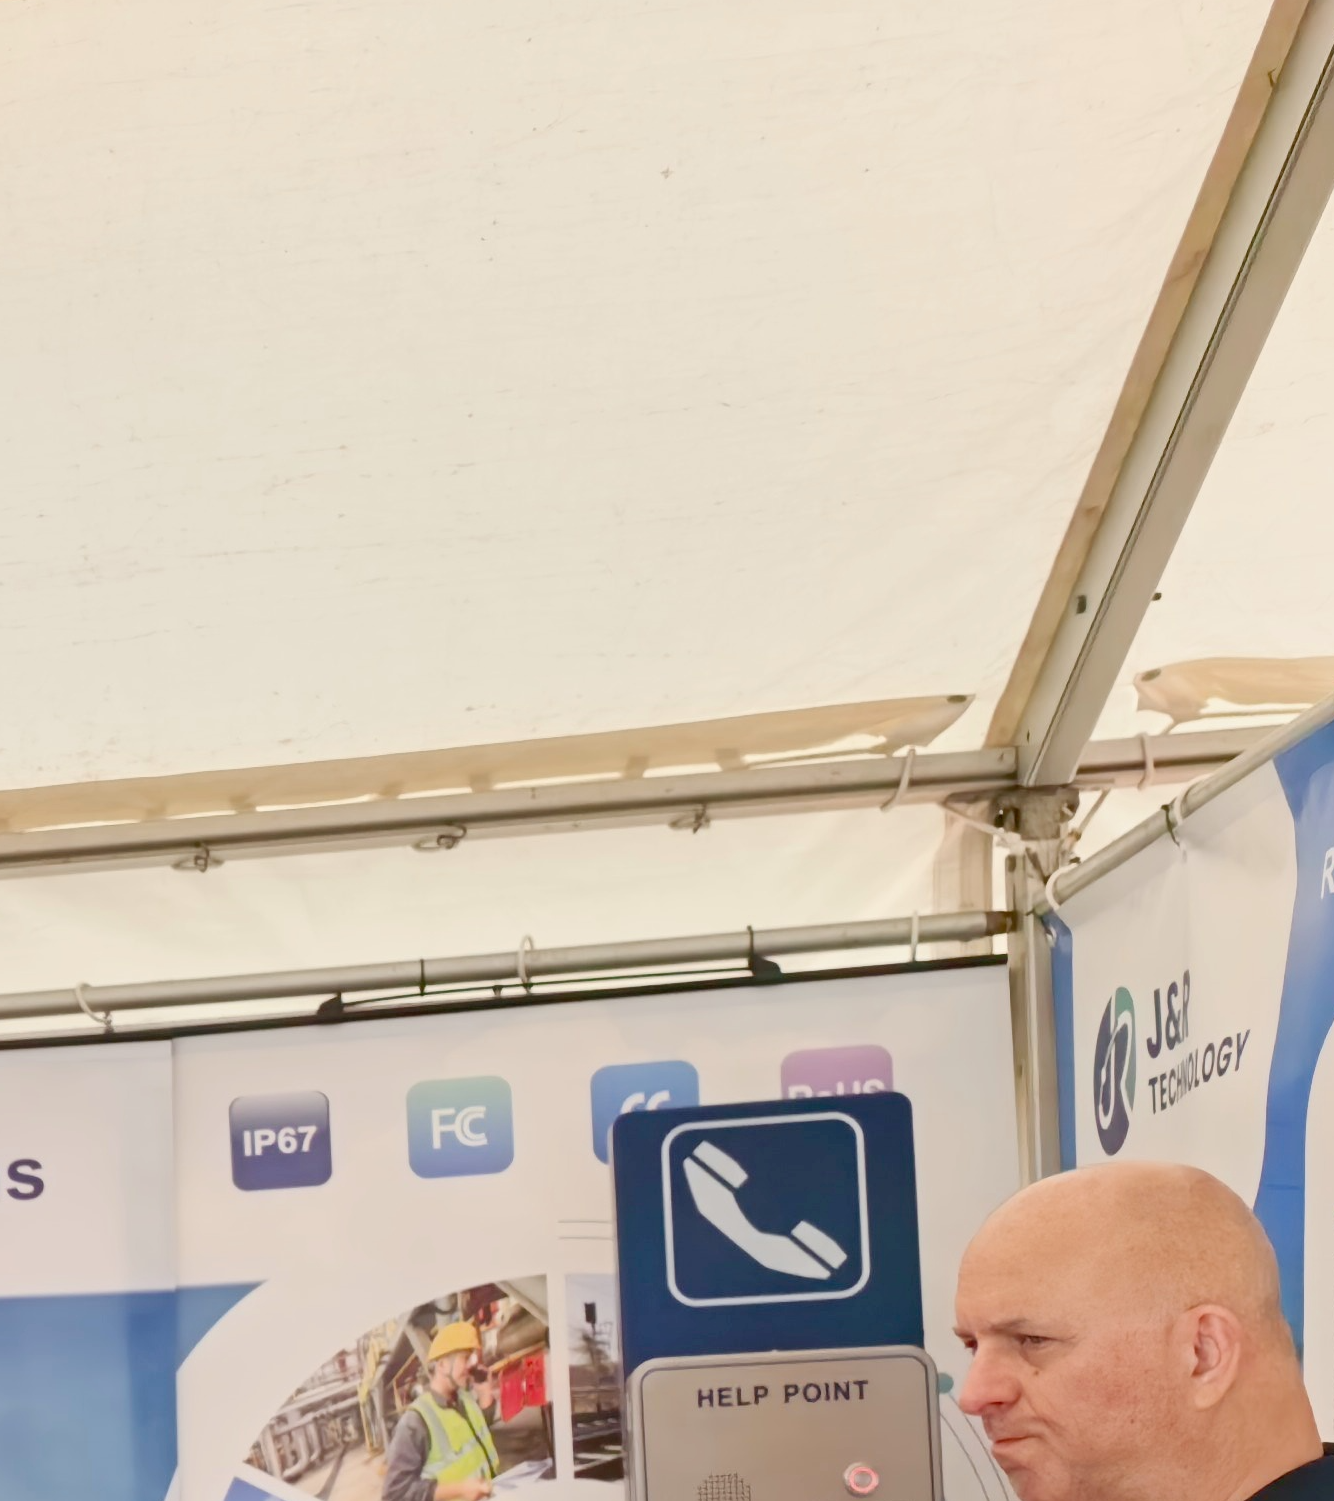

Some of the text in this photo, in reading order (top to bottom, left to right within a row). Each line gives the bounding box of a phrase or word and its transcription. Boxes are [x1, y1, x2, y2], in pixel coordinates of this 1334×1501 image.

[1146, 968, 1191, 1059] J&R
[1148, 1028, 1251, 1116] TECHNOLOGY
[243, 1126, 318, 1157] IP67
[697, 1379, 870, 1408] HELP POINT
